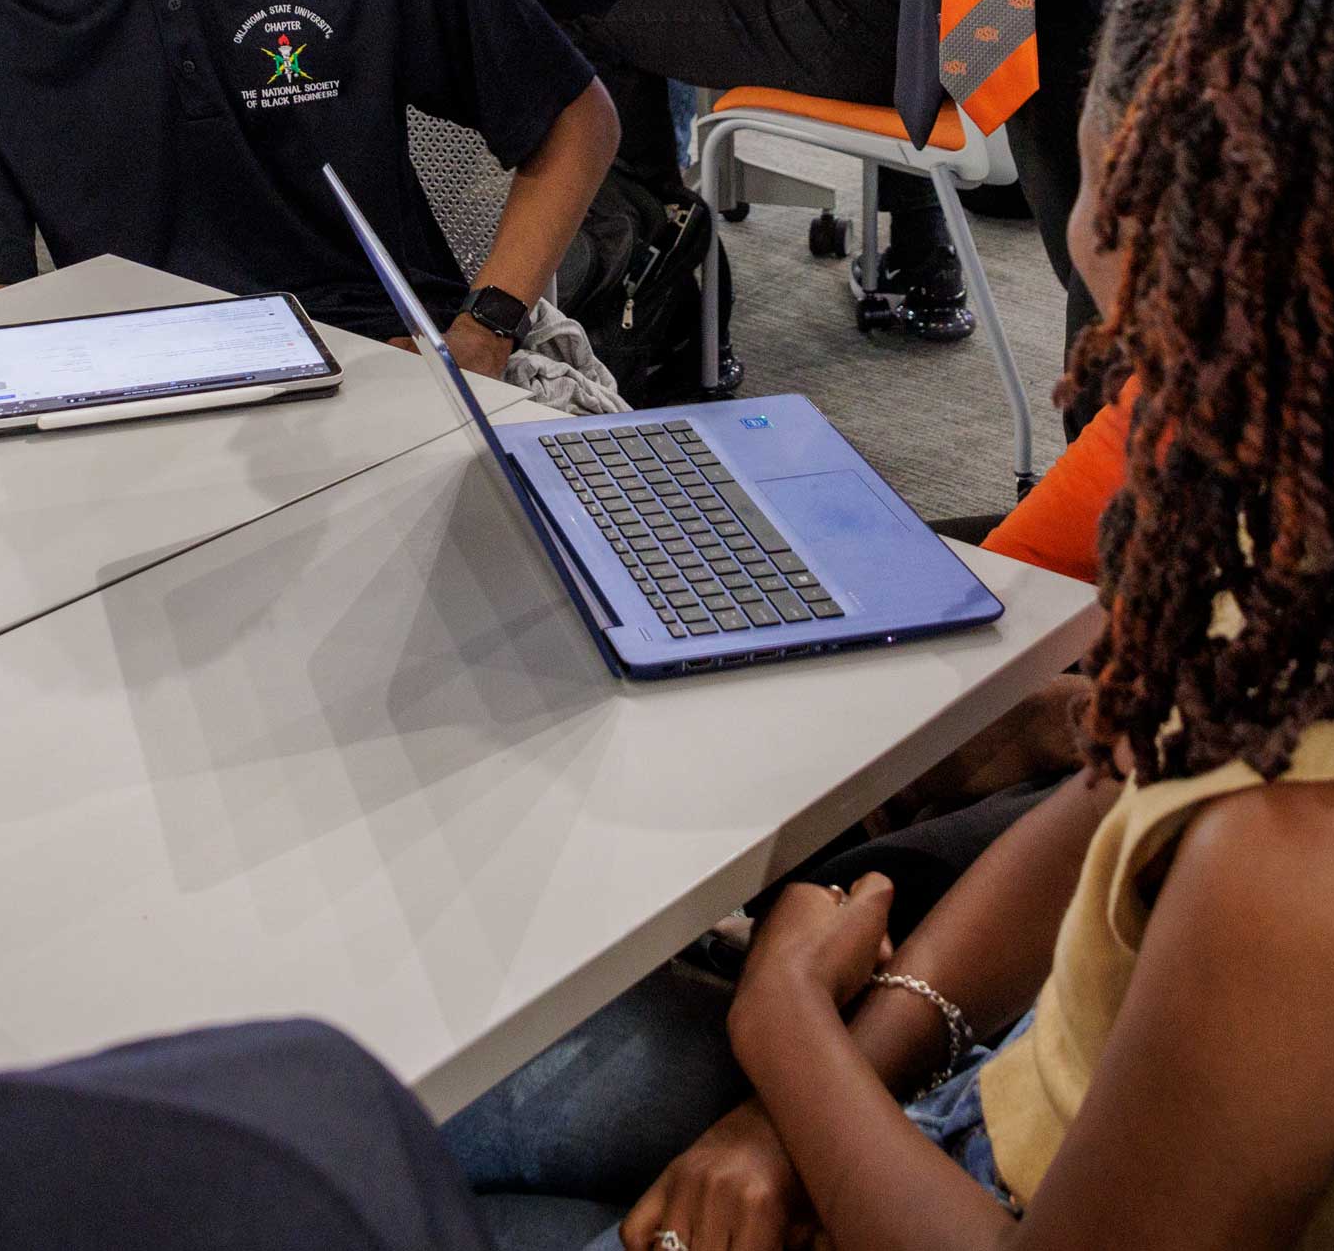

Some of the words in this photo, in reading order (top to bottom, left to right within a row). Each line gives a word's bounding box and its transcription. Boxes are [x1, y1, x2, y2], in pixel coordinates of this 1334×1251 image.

[233, 9, 267, 44] OKLAHOMA
[269, 4, 292, 15] STATE
[264, 20, 302, 33] CHAPTER
[241, 90, 258, 100] THE
[261, 84, 302, 98] NATIONAL
[304, 80, 340, 92] SOCIETY
[246, 99, 258, 109] OF
[261, 96, 290, 108] BLACK
[292, 89, 338, 104] ENGINEERS
